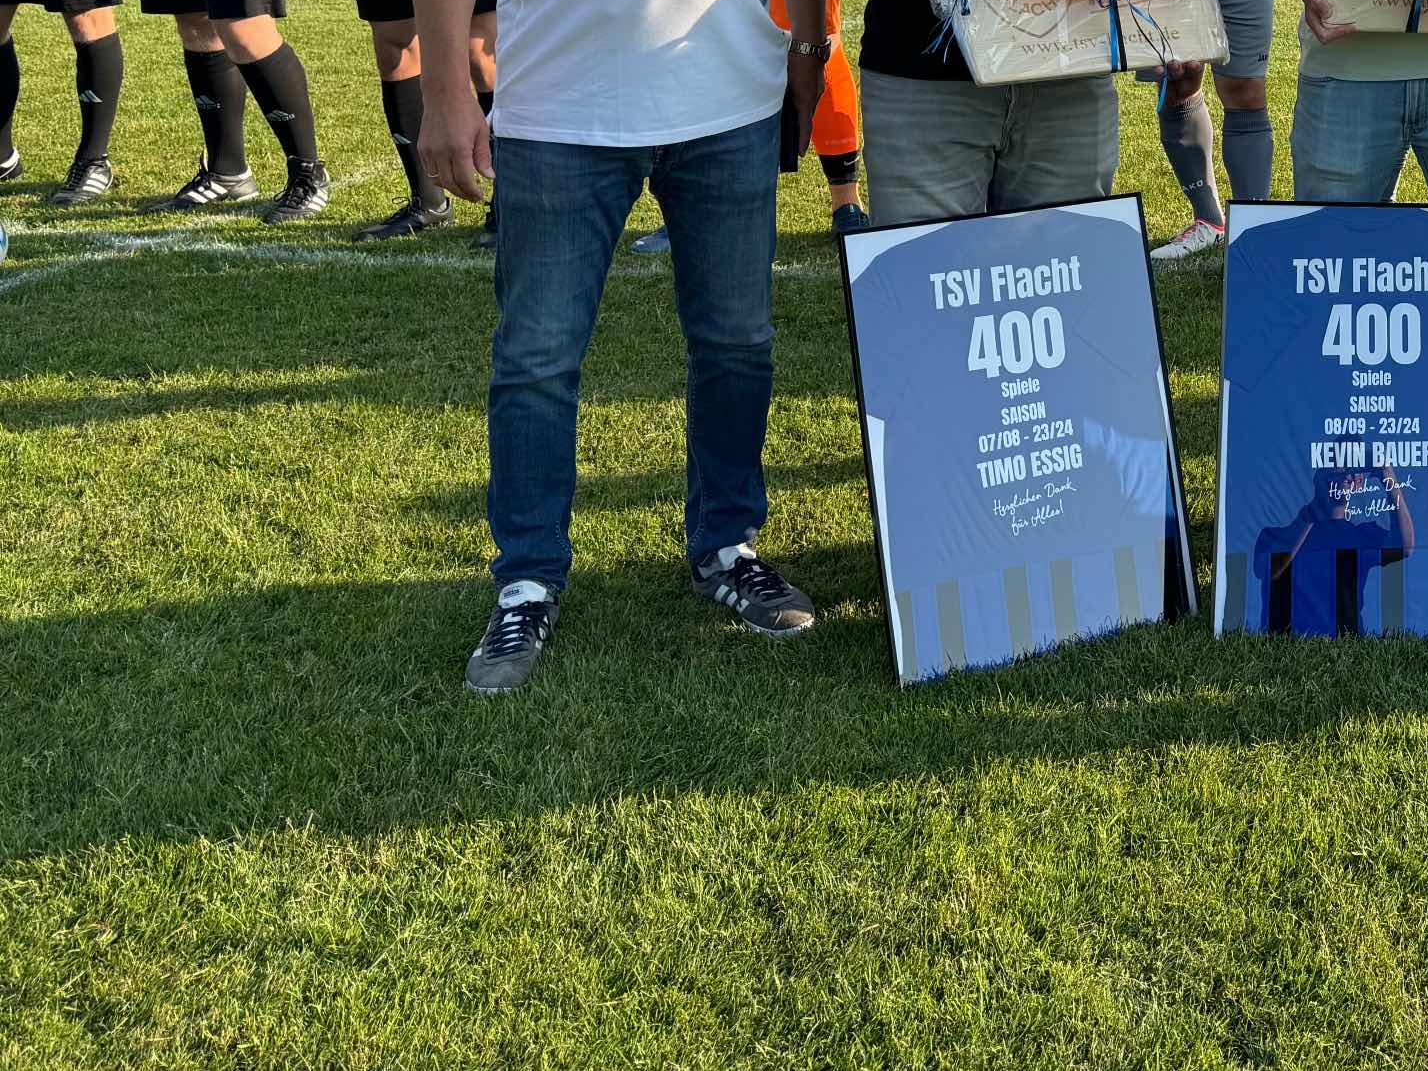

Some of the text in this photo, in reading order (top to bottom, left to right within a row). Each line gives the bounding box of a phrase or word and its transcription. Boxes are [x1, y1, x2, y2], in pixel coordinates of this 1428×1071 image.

[929, 255, 1083, 310] TSV Flacht
[1293, 257, 1343, 294] TSV
[967, 306, 1066, 378] 400
[1321, 302, 1422, 366] 400
[1001, 377, 1041, 399] Spiele
[1351, 370, 1392, 388] Spiele
[1000, 400, 1047, 426] SAISON
[1349, 395, 1395, 413] SAISON
[978, 428, 1021, 453] 07/08
[1032, 418, 1074, 443] 23/24
[1324, 417, 1367, 435] 08/09
[1378, 417, 1421, 434] 23/24
[976, 443, 1084, 489] TIMO ESSIG
[1310, 441, 1366, 469] KEVIN
[992, 476, 1078, 517] Herzlichen Dank
[1328, 474, 1417, 501] Herzlichen Dank
[1011, 498, 1064, 537] für Alles!
[1343, 494, 1401, 522] für Alles!
